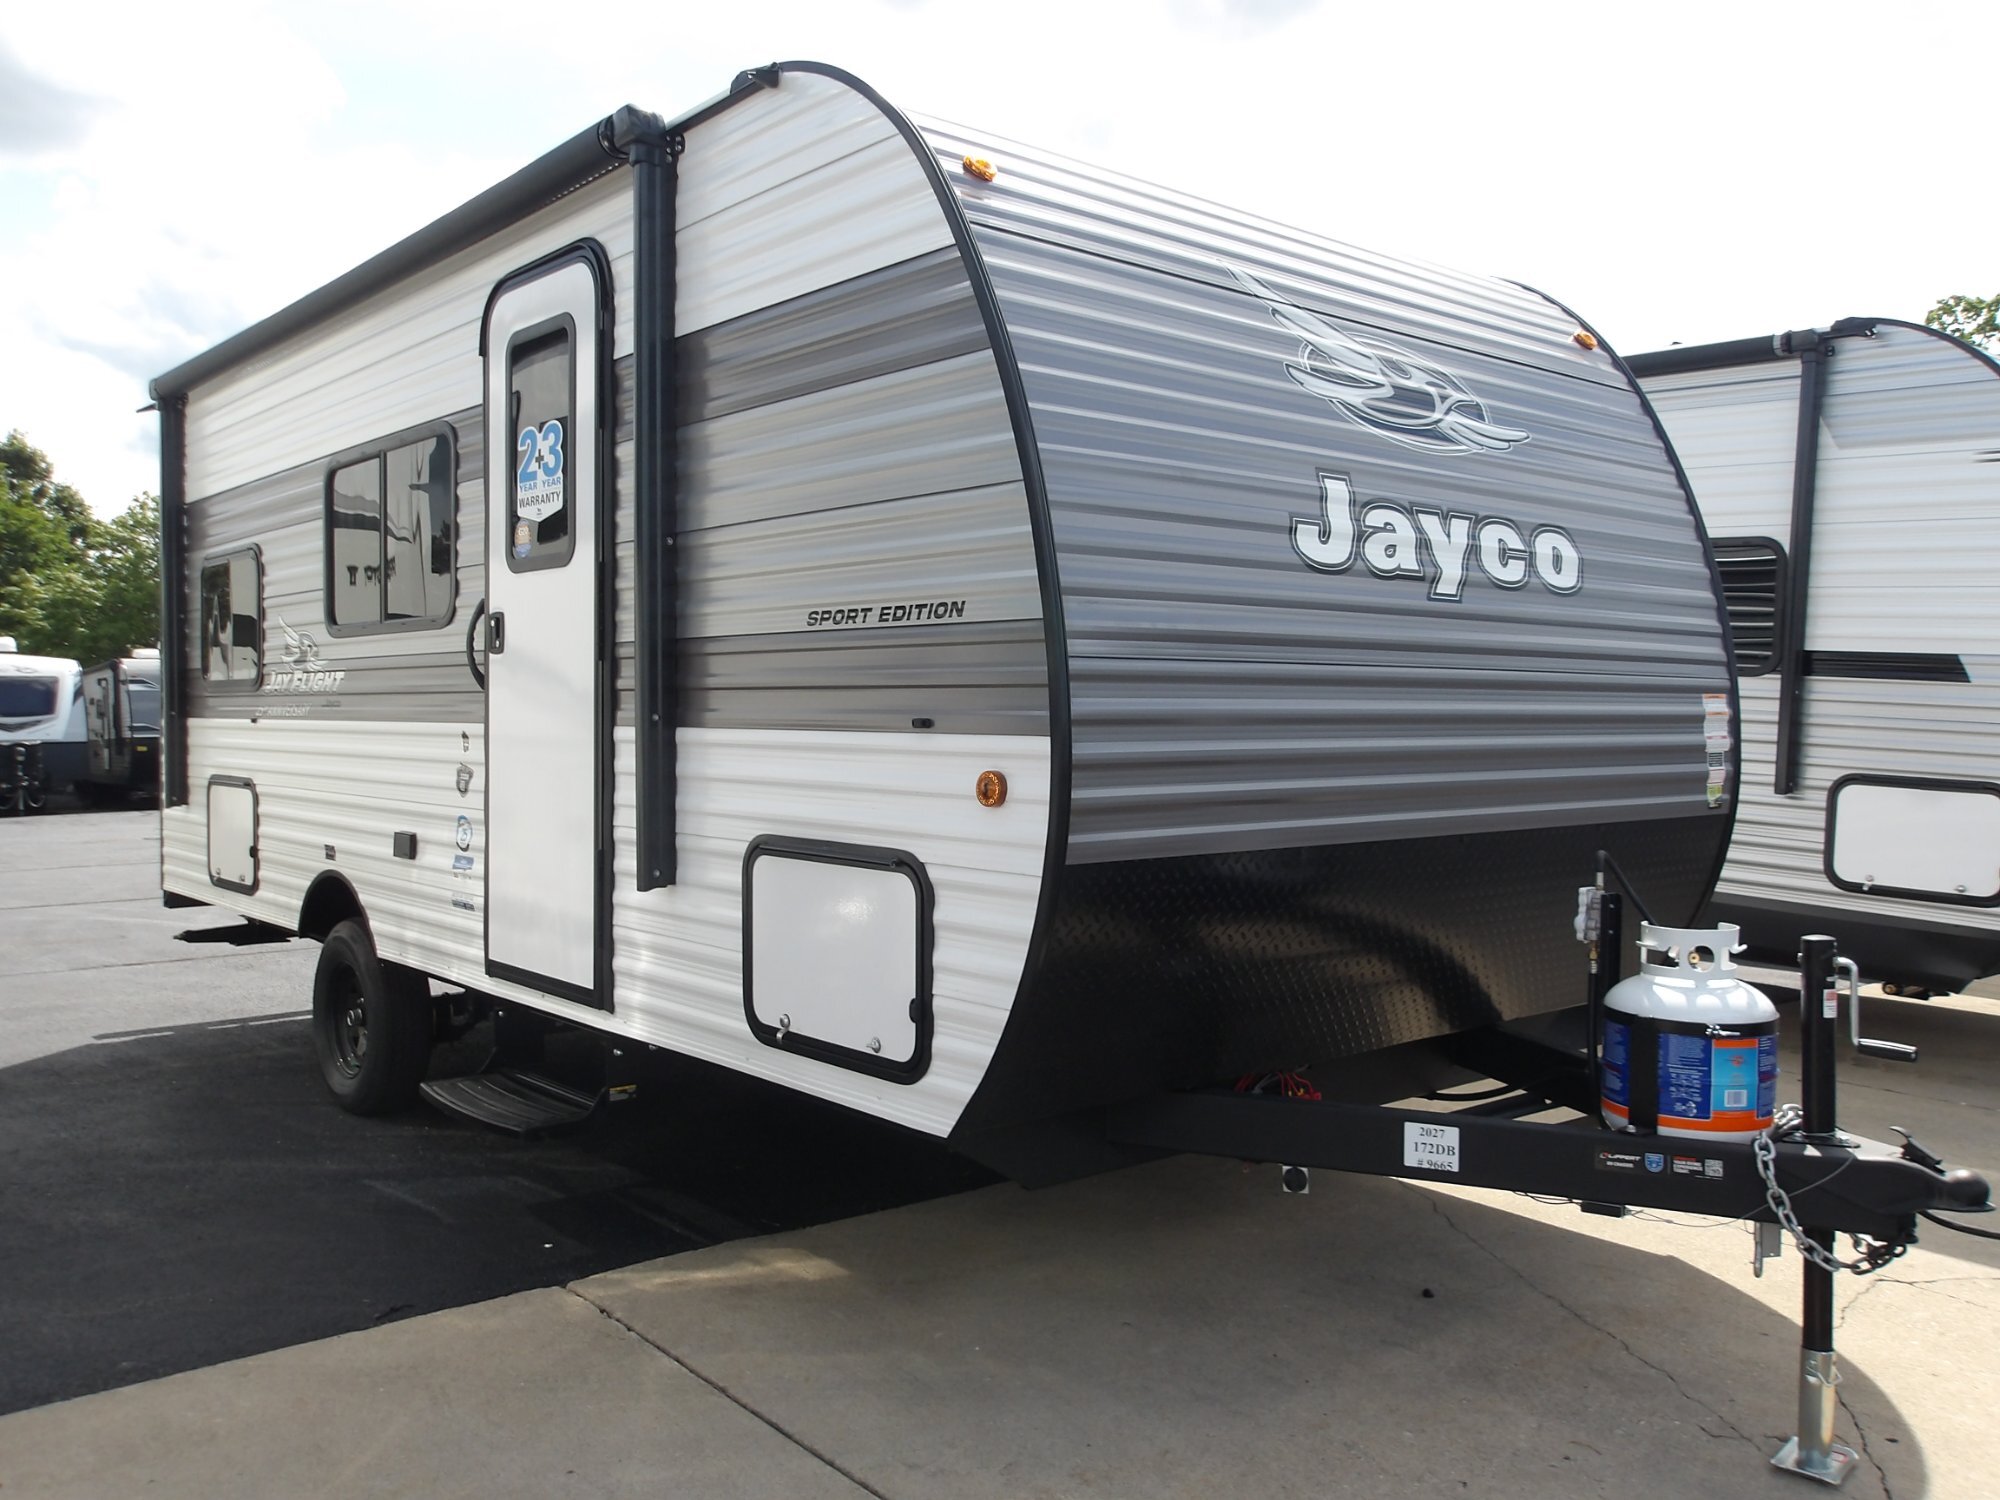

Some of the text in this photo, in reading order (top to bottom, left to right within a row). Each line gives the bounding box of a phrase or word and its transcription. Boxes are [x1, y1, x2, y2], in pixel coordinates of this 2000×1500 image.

[519, 477, 561, 492] YEAR YEAR
[519, 491, 561, 509] WARRANTY
[1290, 467, 1583, 602] Jayco
[807, 600, 966, 626] SPORT EDITION
[264, 671, 345, 692] JAY FLIGHT
[1419, 1127, 1445, 1139] 2027
[1414, 1142, 1456, 1156] 172DB
[1427, 1159, 1453, 1170] 9665
